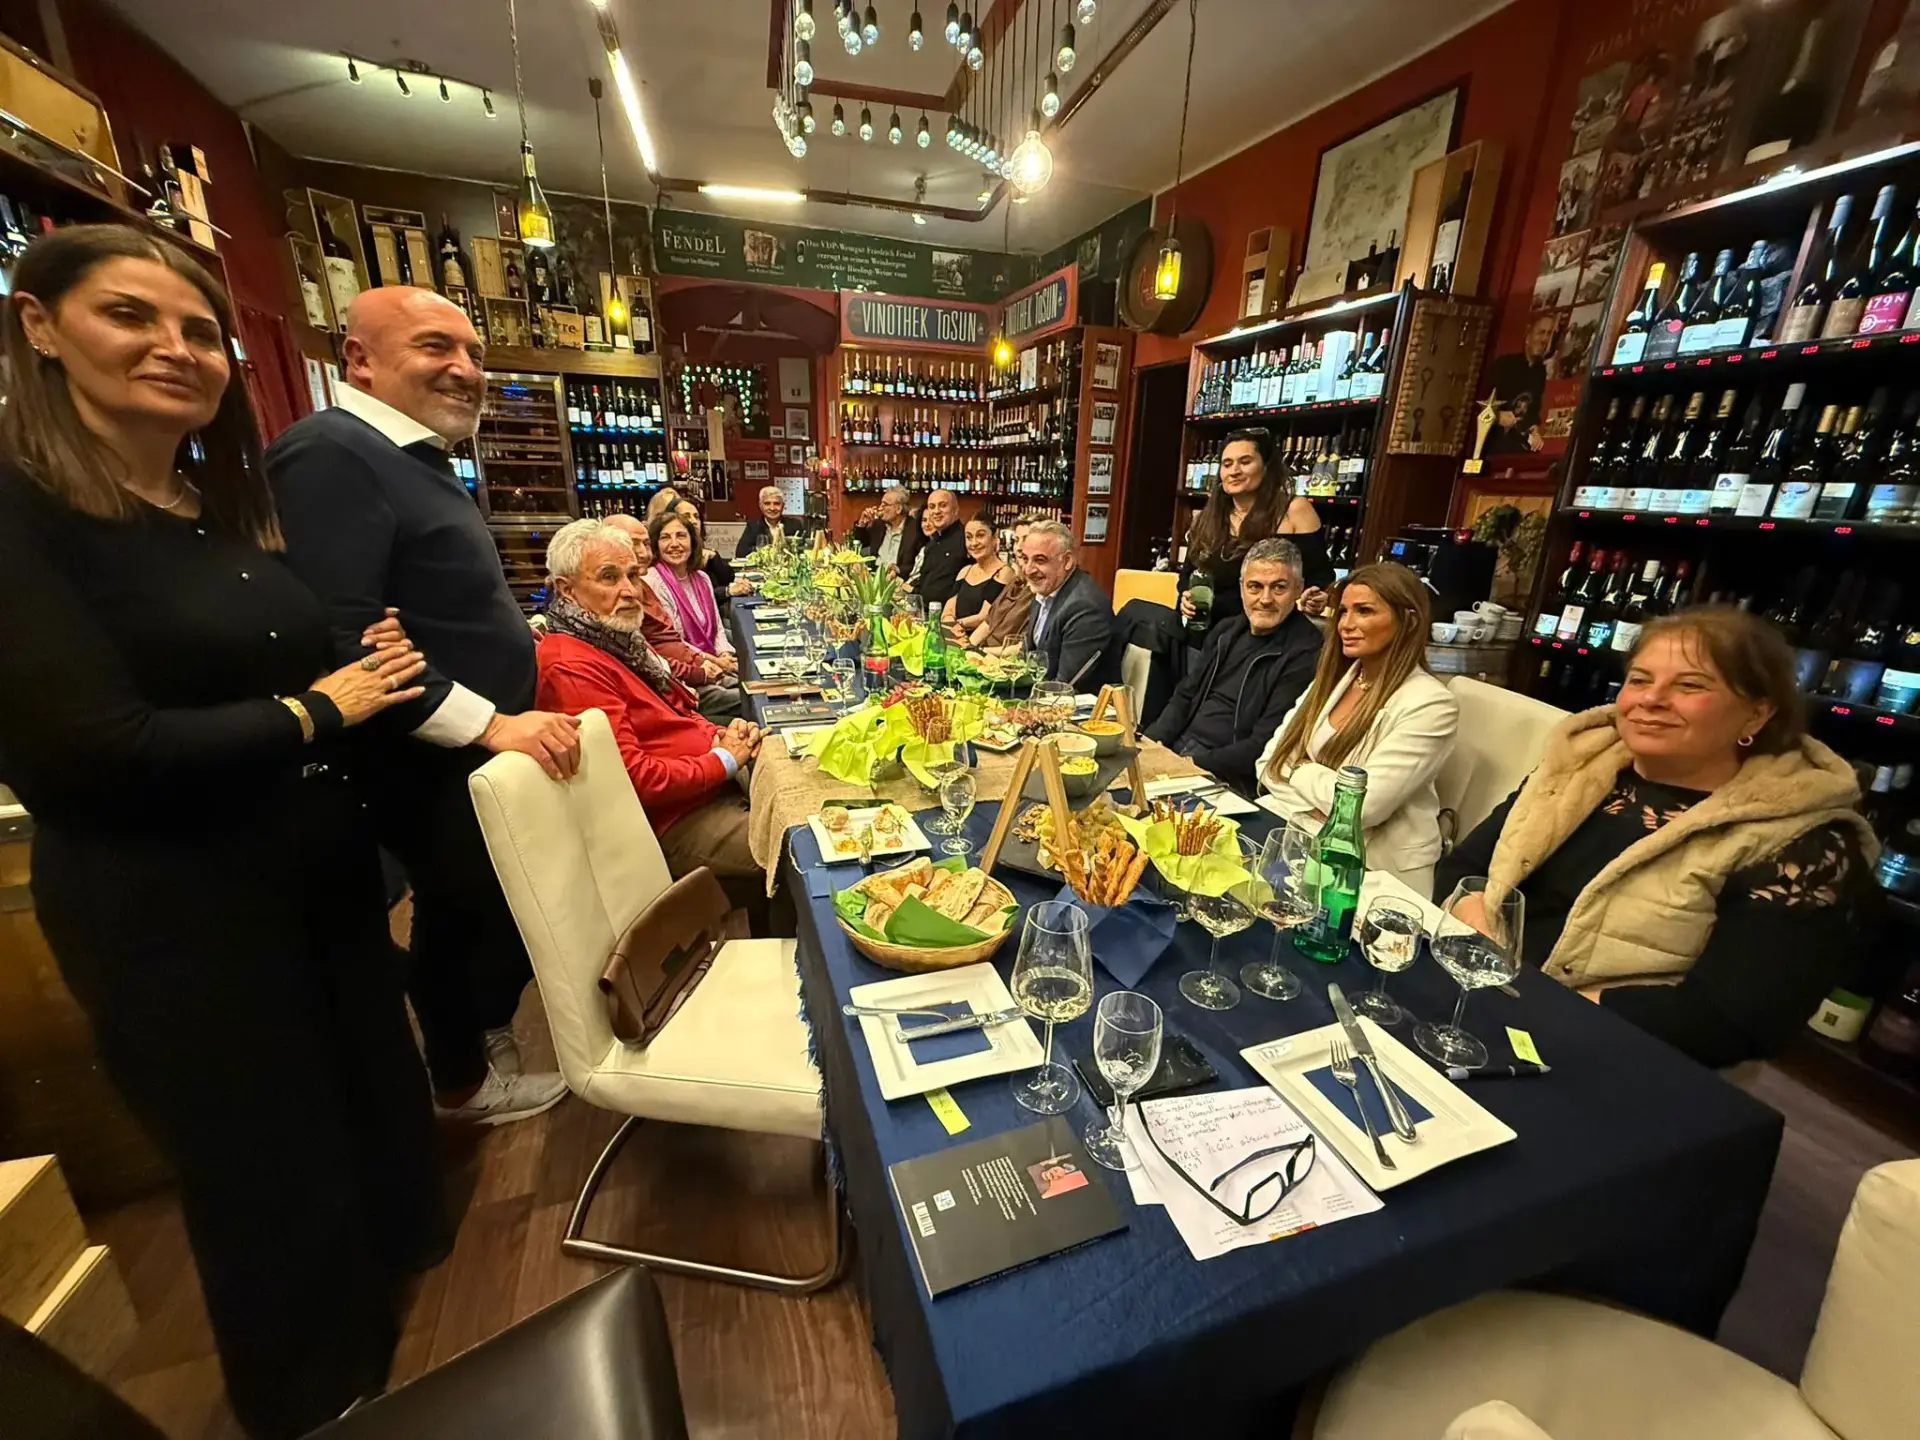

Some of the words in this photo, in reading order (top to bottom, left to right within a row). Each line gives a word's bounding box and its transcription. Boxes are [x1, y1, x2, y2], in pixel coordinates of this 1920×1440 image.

[662, 229, 725, 254] FENDEL
[862, 301, 929, 340] VINOTHEK
[1005, 295, 1032, 337] INOTHEK
